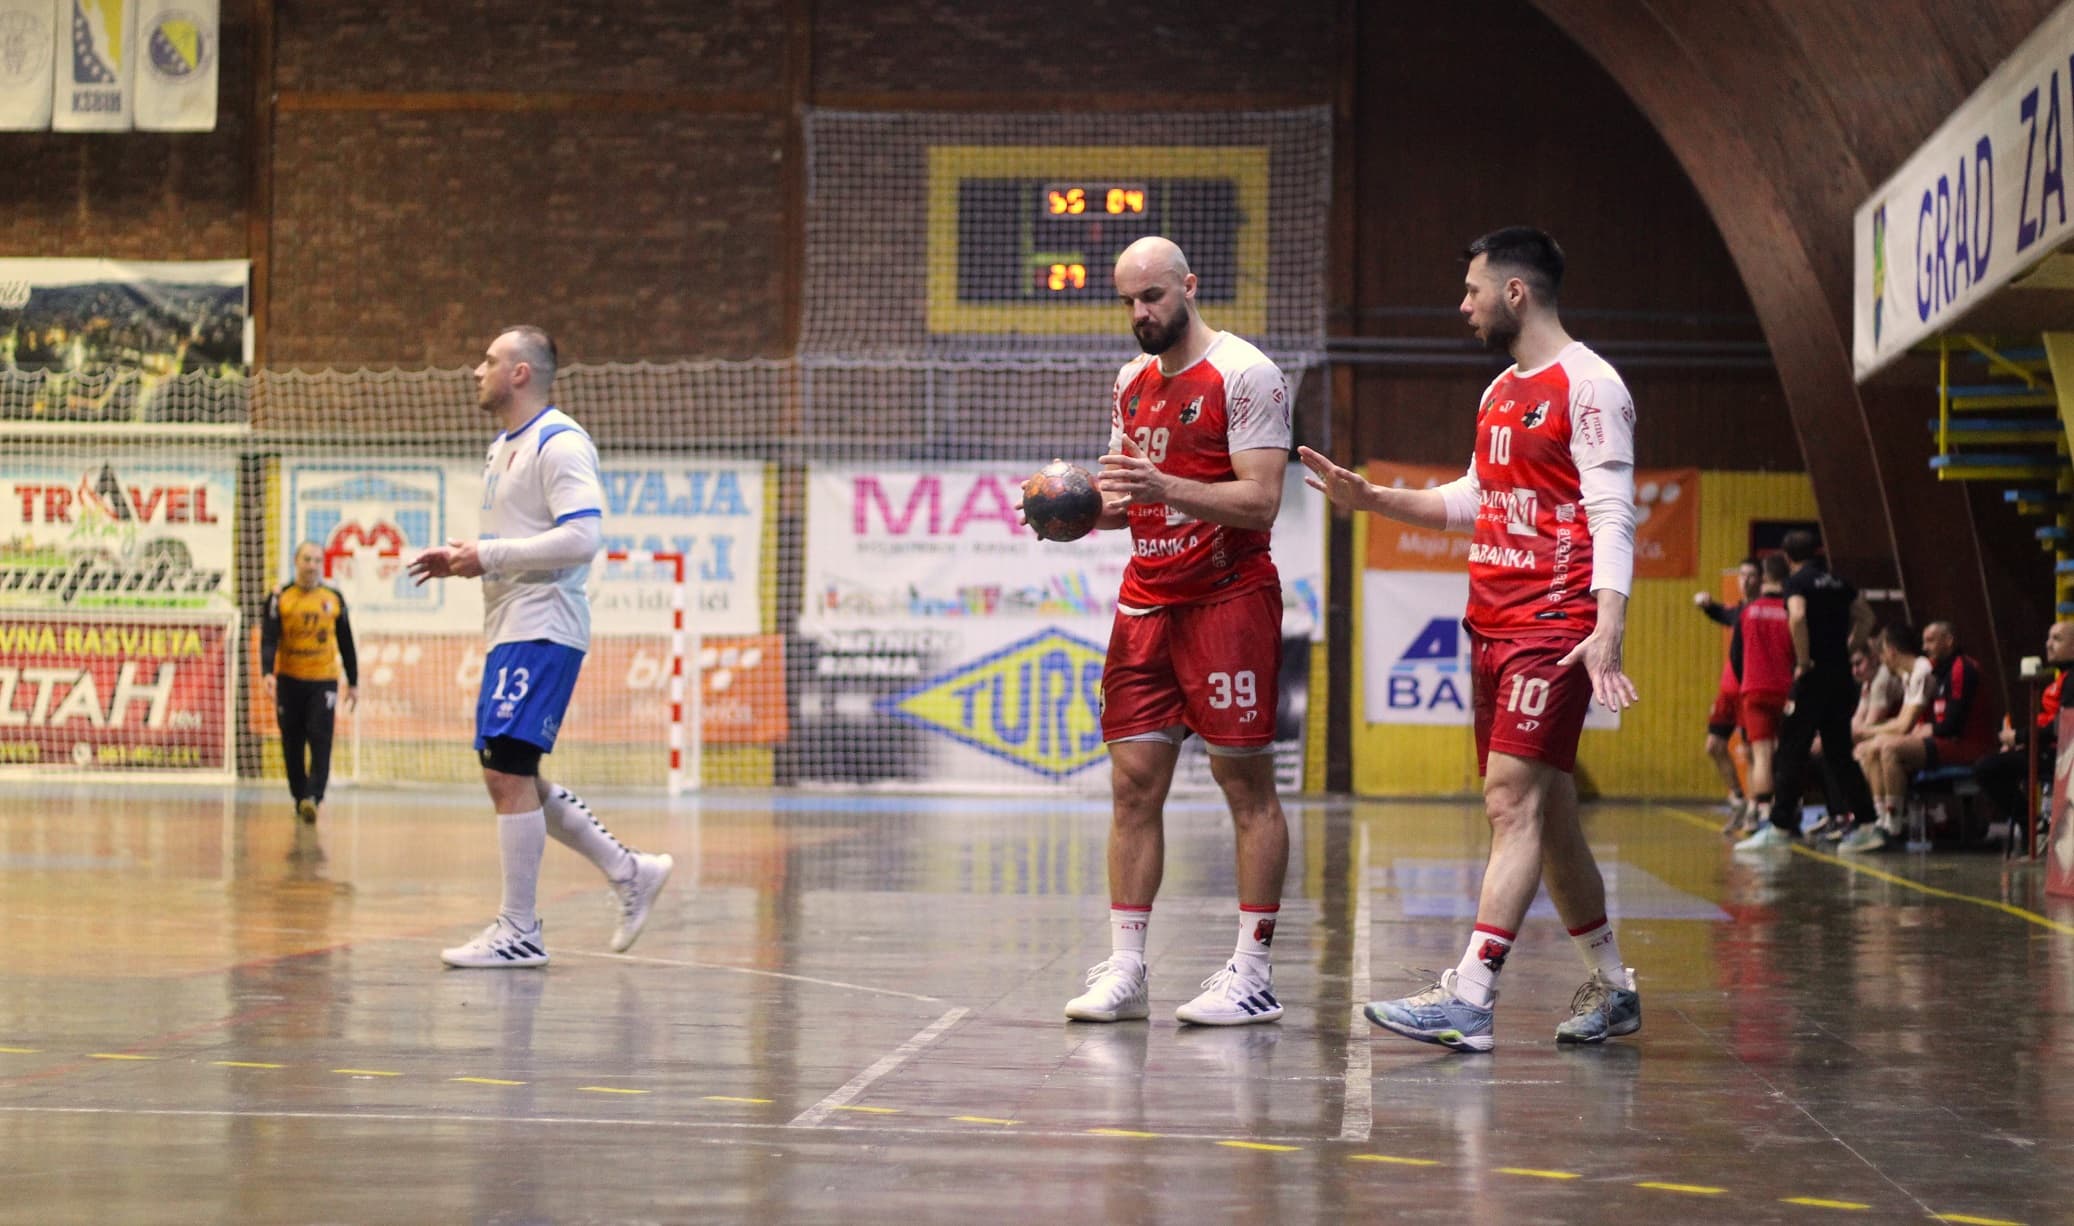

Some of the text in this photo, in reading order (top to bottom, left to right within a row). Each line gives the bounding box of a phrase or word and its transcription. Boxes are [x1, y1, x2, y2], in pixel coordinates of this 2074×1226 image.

[1917, 53, 2074, 323] GRAD ZA
[1135, 426, 1170, 464] 39
[1489, 425, 1512, 466] 10
[15, 461, 218, 523] TRAVEL
[853, 474, 1029, 535] MA
[64, 627, 203, 657] RASVJETA
[492, 667, 529, 701] 13
[1208, 670, 1256, 709] 39
[1507, 674, 1550, 717] 10
